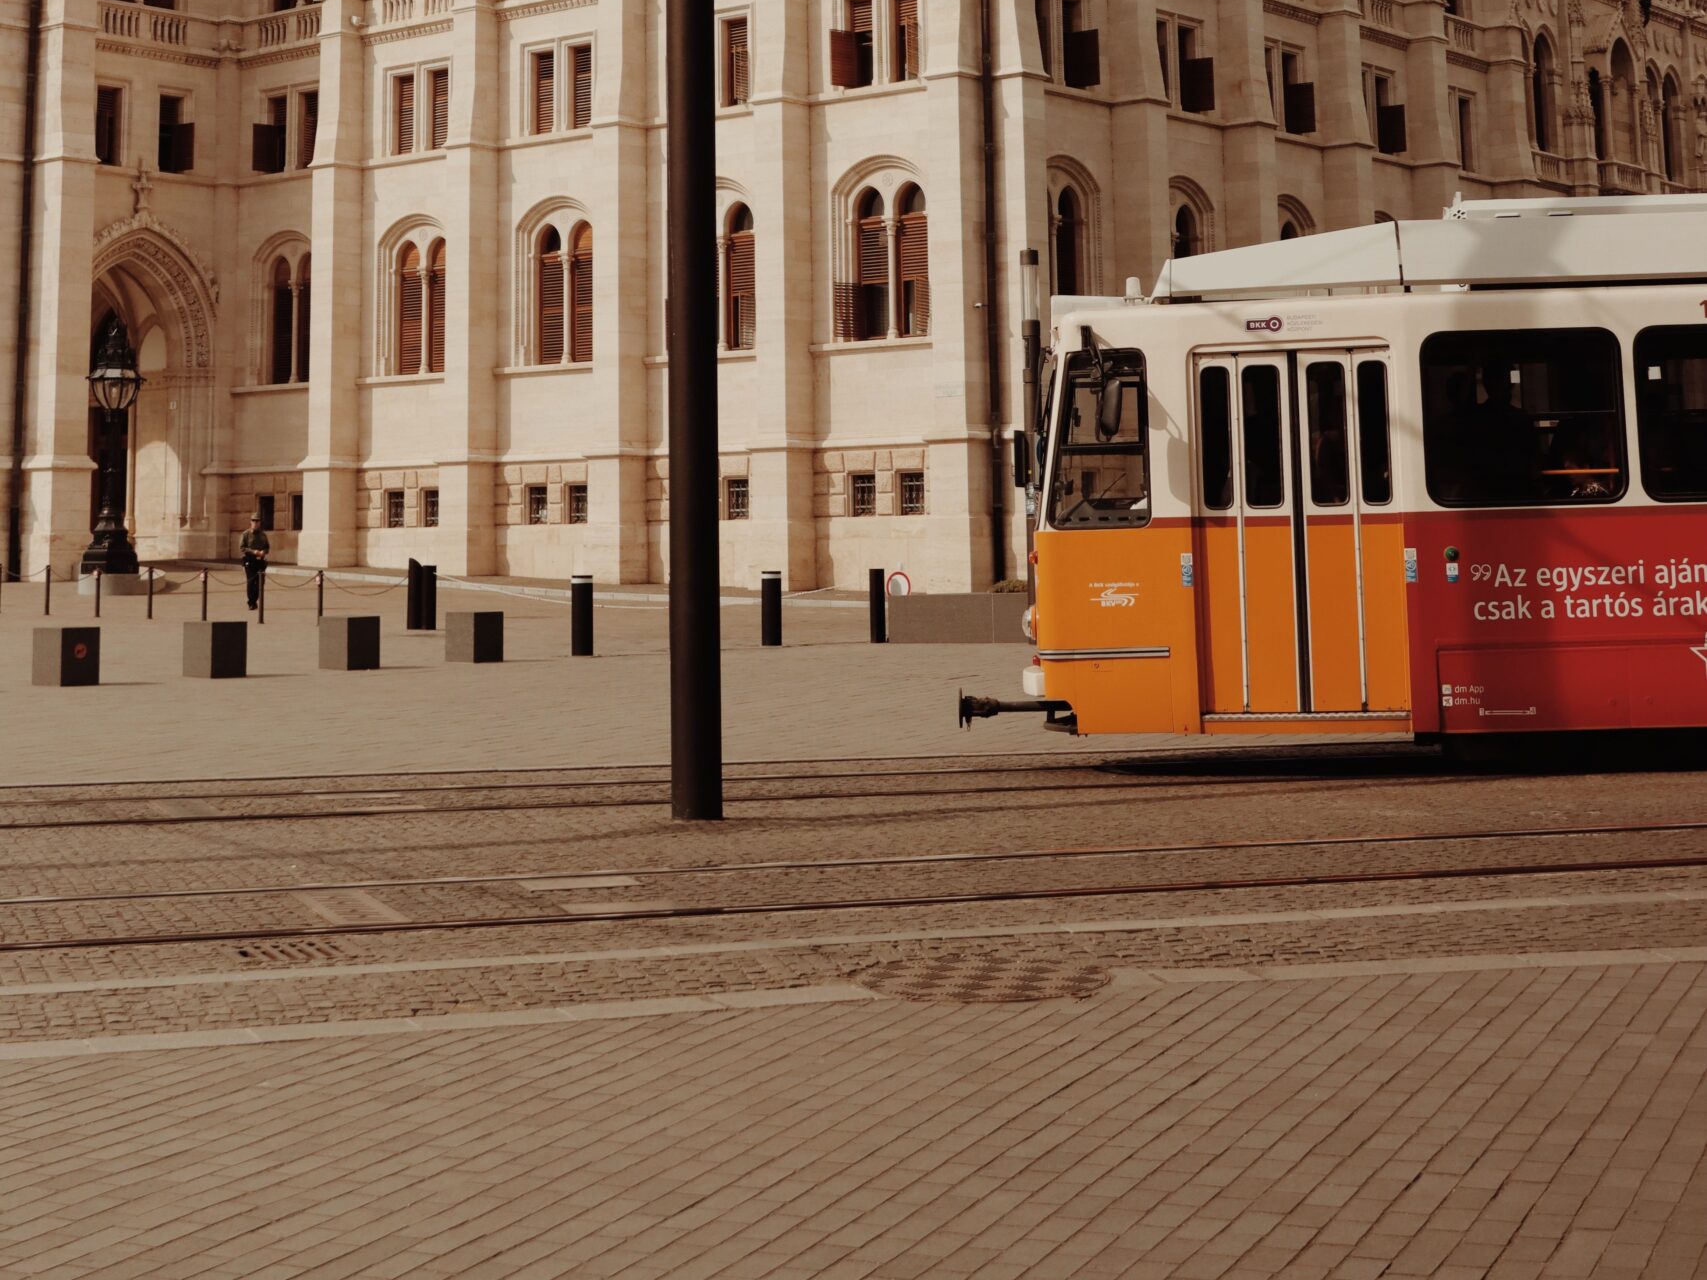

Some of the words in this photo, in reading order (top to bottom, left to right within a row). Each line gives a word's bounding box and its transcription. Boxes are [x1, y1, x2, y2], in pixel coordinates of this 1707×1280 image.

[1249, 321, 1267, 329] BKK
[1536, 559, 1644, 592] egyszeri
[1473, 594, 1532, 621] csak
[1540, 600, 1555, 619] a
[1564, 591, 1643, 619] tartós
[1652, 590, 1707, 617] árak
[1454, 685, 1467, 693] dm
[1454, 696, 1480, 705] dm.hu
